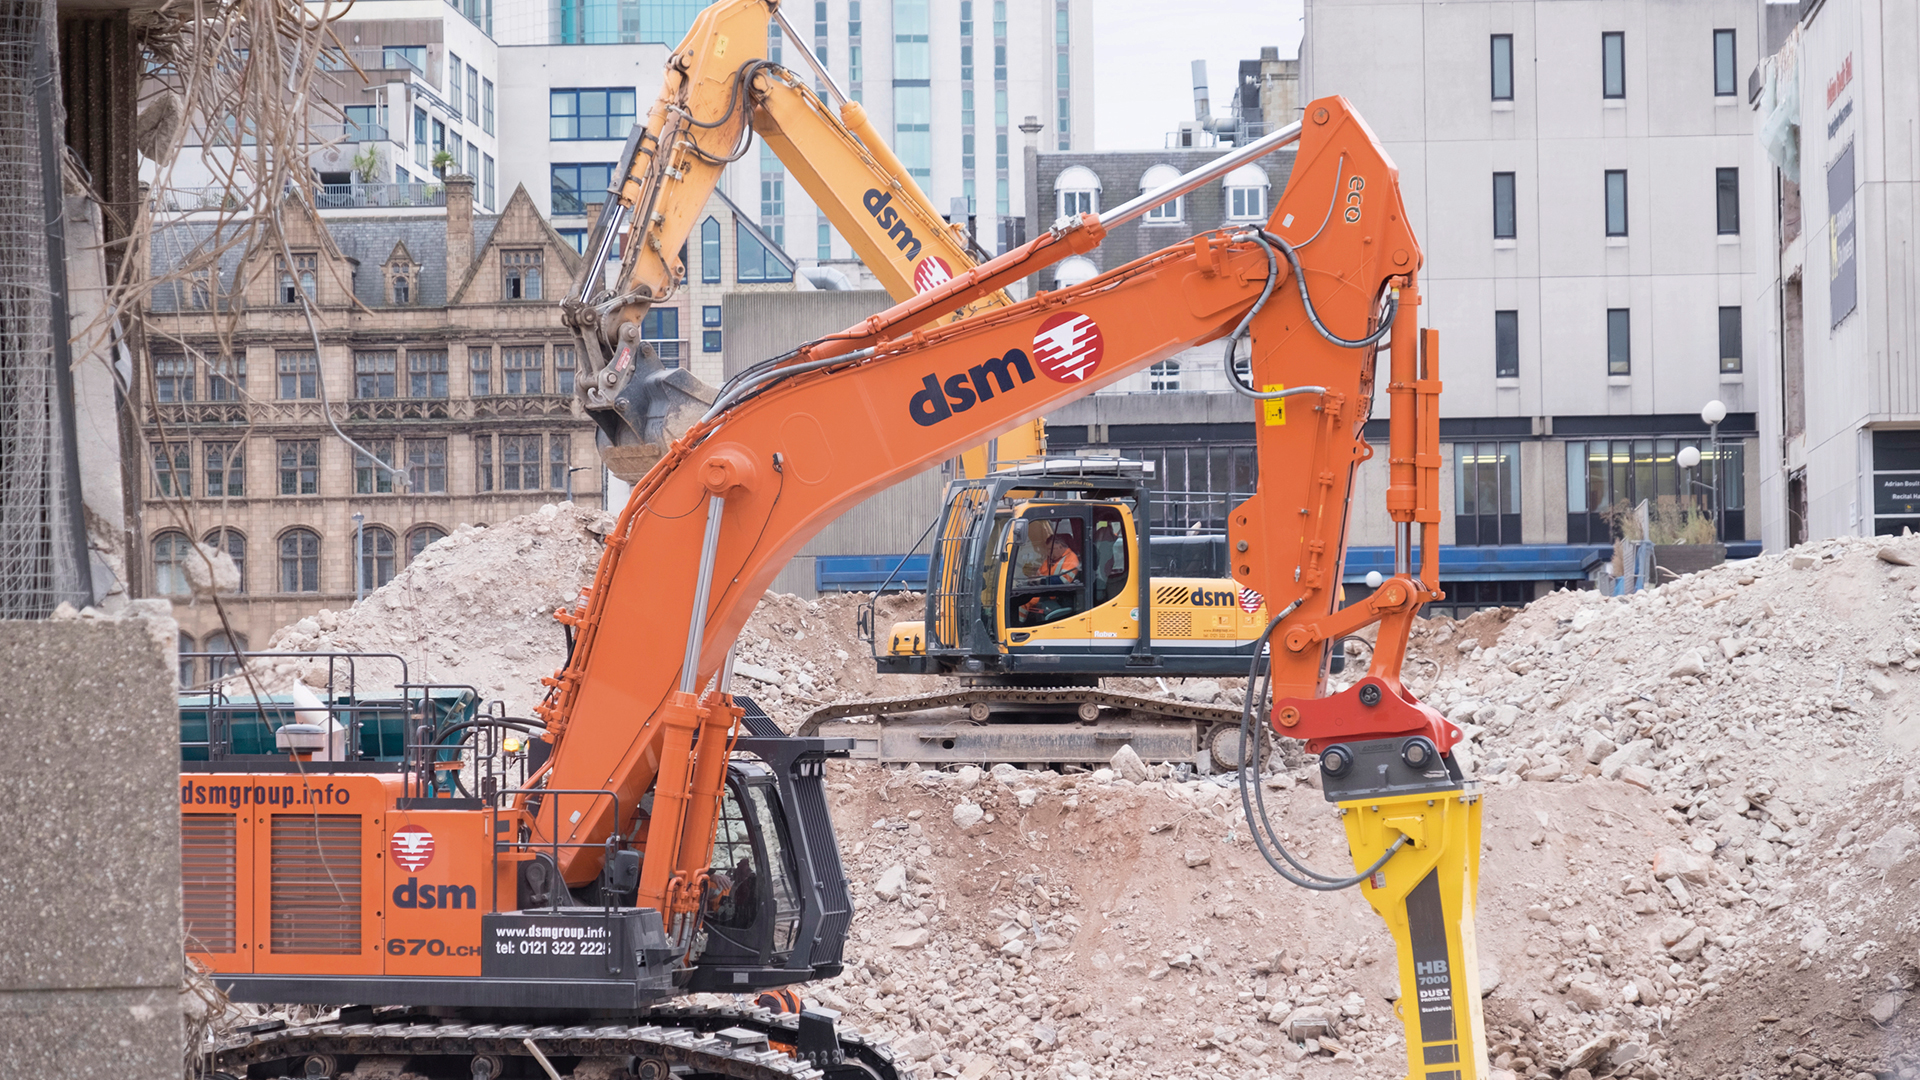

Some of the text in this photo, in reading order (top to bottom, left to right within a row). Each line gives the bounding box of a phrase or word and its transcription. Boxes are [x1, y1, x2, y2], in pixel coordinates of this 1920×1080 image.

[1344, 175, 1366, 224] eco
[862, 188, 922, 262] dsm
[909, 348, 1036, 427] dsm
[1190, 586, 1235, 606] dsm
[181, 780, 350, 809] dsmgroup.info
[392, 877, 476, 909] dsm
[496, 941, 515, 954] tel:
[520, 941, 547, 955] 0121
[551, 941, 575, 955] 322
[1416, 960, 1448, 975] HB
[1418, 975, 1449, 985] 7000
[1420, 988, 1450, 998] DUST
